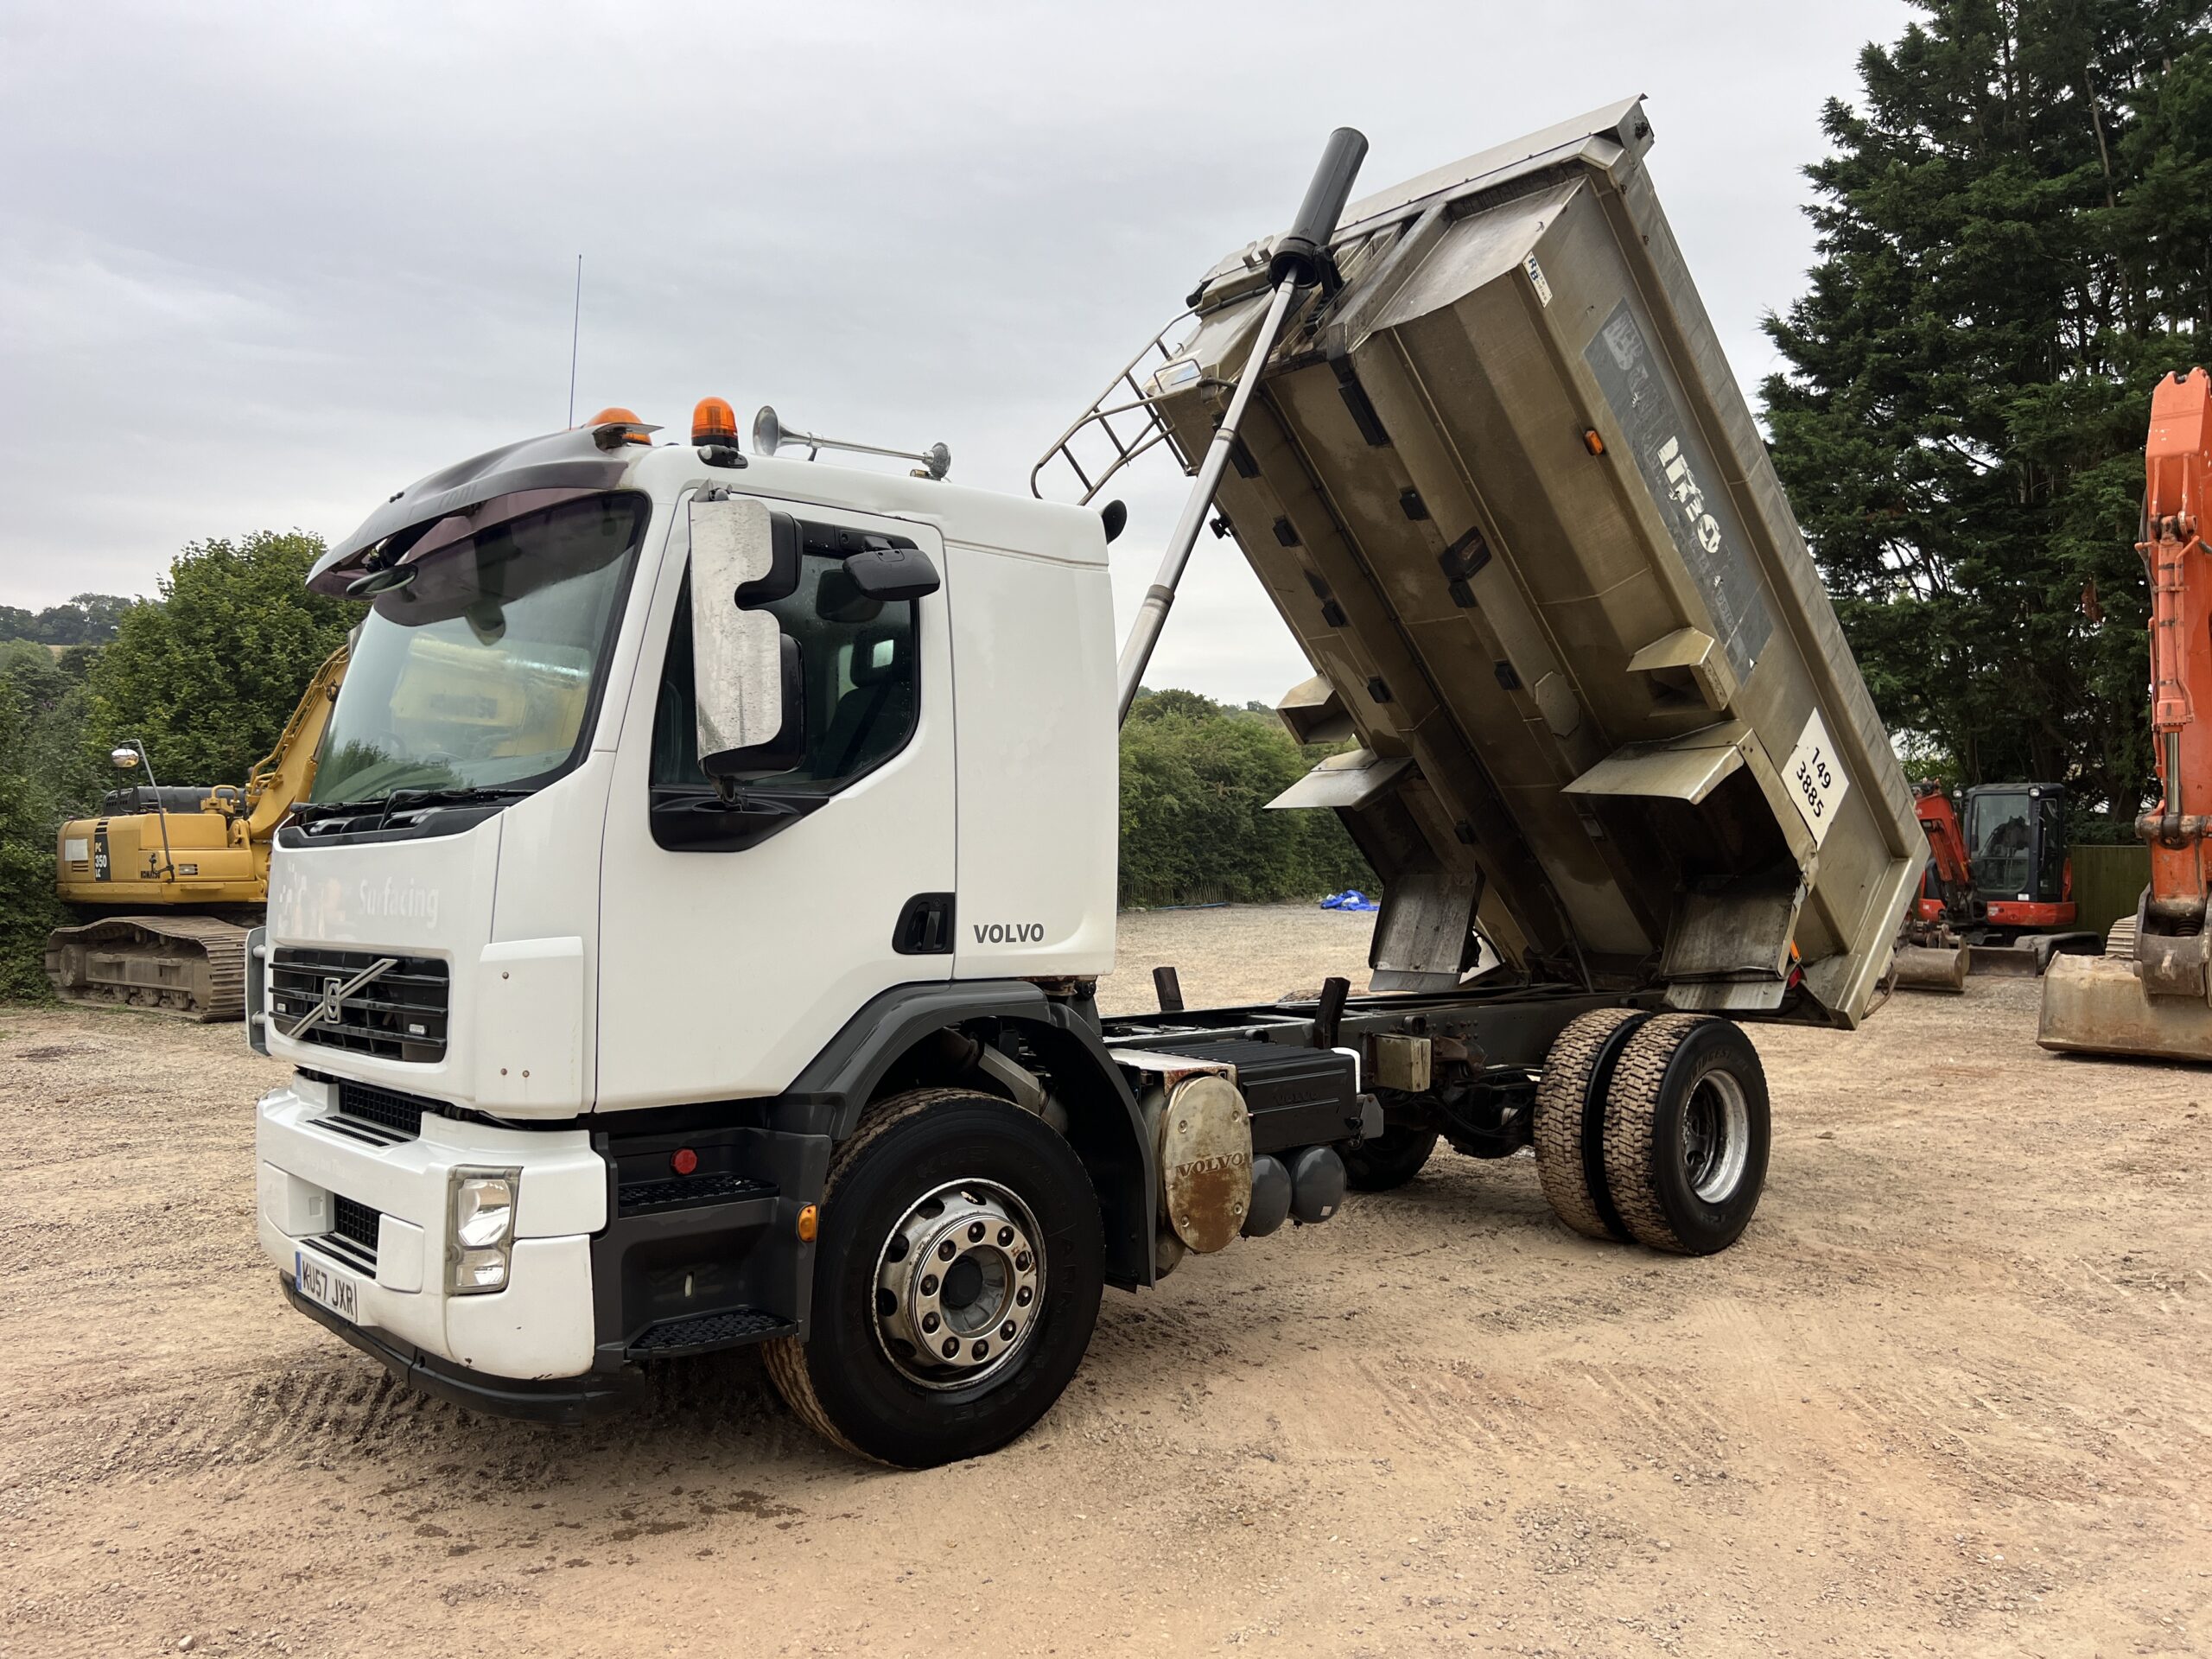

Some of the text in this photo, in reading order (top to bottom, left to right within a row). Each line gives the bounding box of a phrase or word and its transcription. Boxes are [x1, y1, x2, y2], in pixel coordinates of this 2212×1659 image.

[1796, 760, 1825, 817] 3885
[1811, 747, 1832, 789] 149
[95, 855, 107, 868] 350
[359, 876, 439, 929] Surfacing
[973, 923, 1044, 944] VOLVO
[1175, 1152, 1244, 1178] VOLVO
[302, 1261, 353, 1316] KU57 JXR
